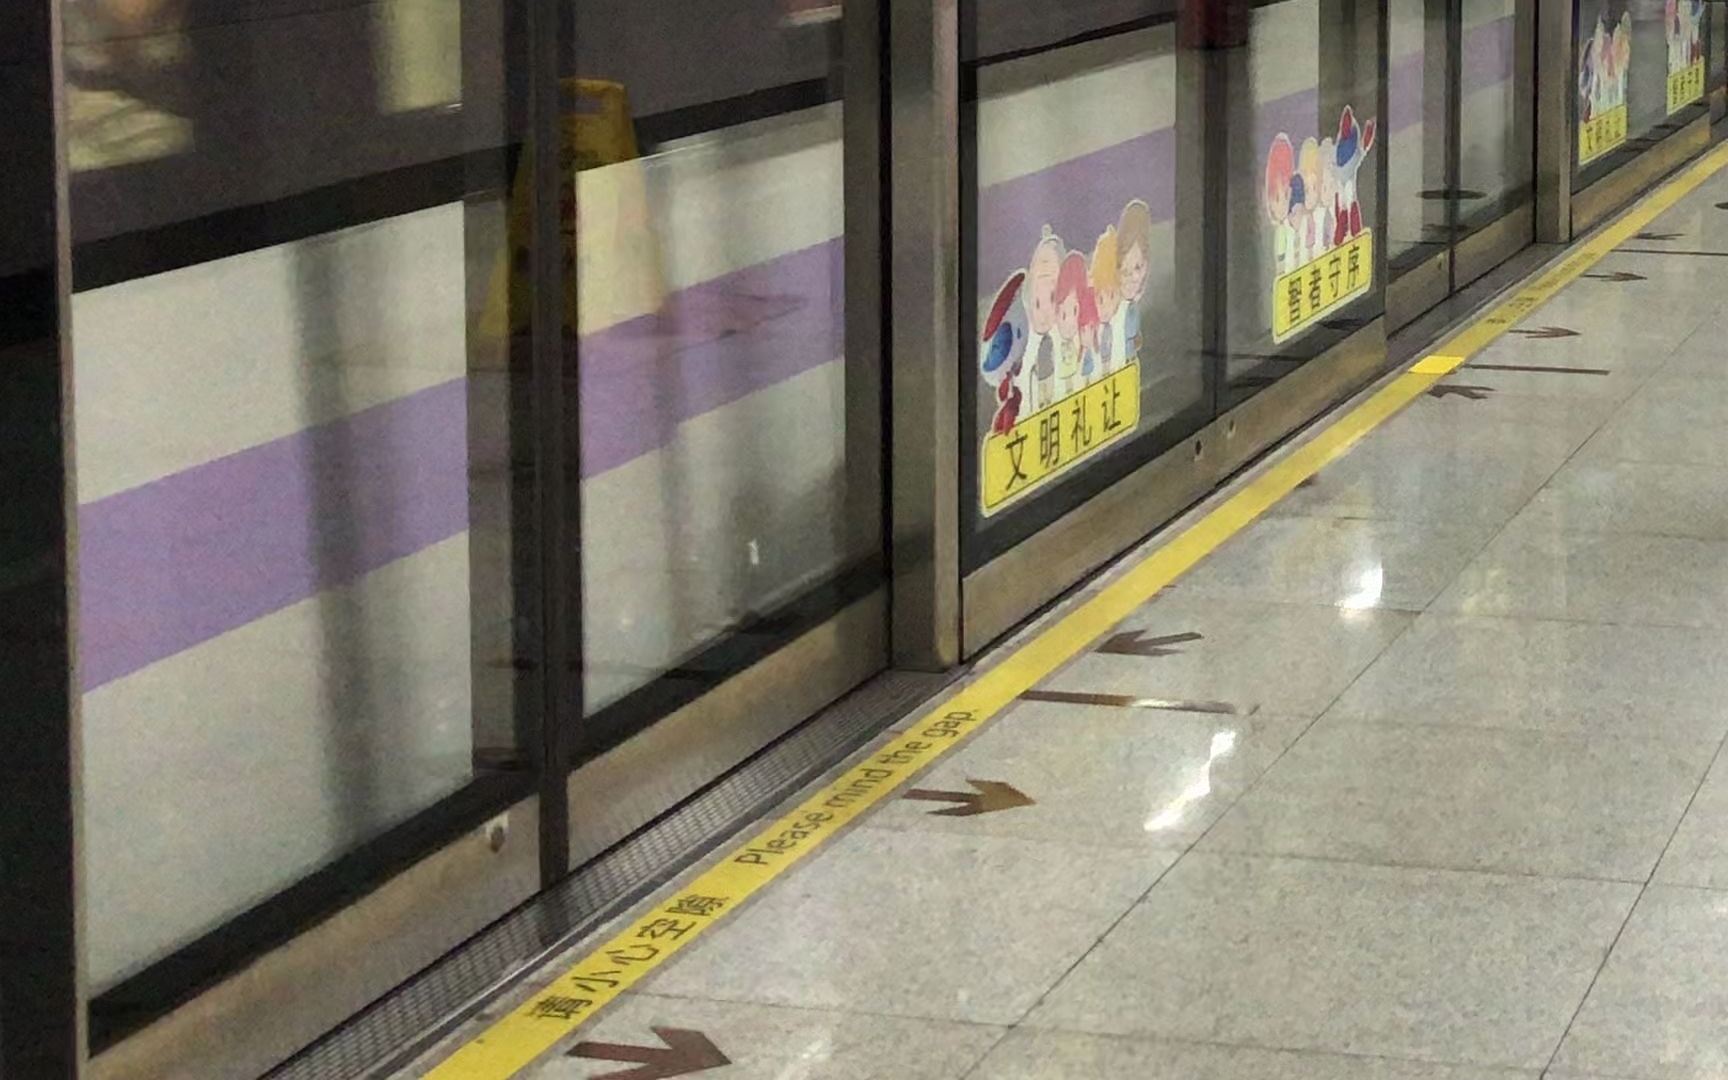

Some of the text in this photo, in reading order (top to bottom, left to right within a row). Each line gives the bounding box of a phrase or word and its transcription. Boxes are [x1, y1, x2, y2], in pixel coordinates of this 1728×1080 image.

[1006, 380, 1122, 492] 文明礼让
[733, 810, 835, 866] Please
[824, 768, 893, 810] mind
[877, 740, 933, 768] the
